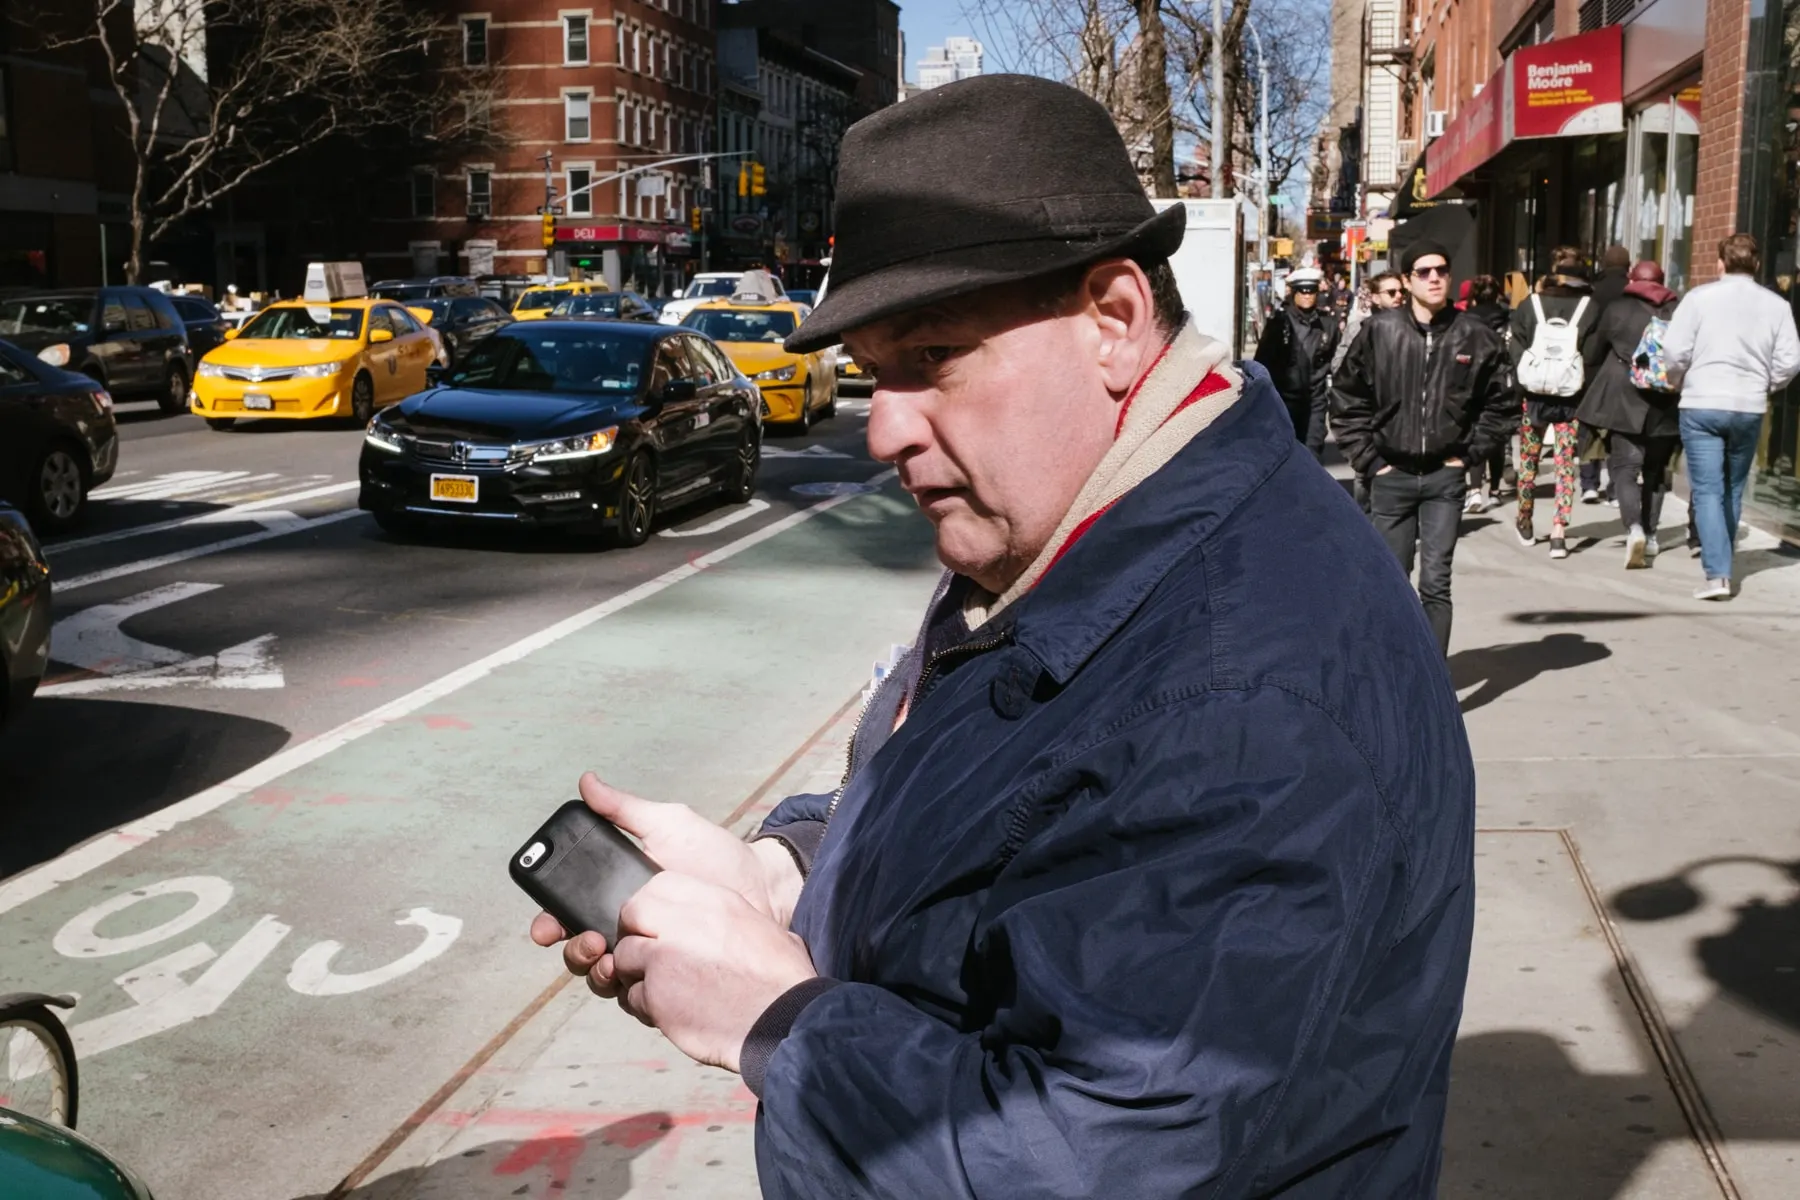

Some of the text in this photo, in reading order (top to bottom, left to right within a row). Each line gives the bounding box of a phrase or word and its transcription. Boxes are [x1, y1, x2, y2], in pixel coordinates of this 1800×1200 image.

[1527, 60, 1592, 77] Benjamin
[1527, 76, 1573, 90] Moore
[574, 228, 596, 240] DELI
